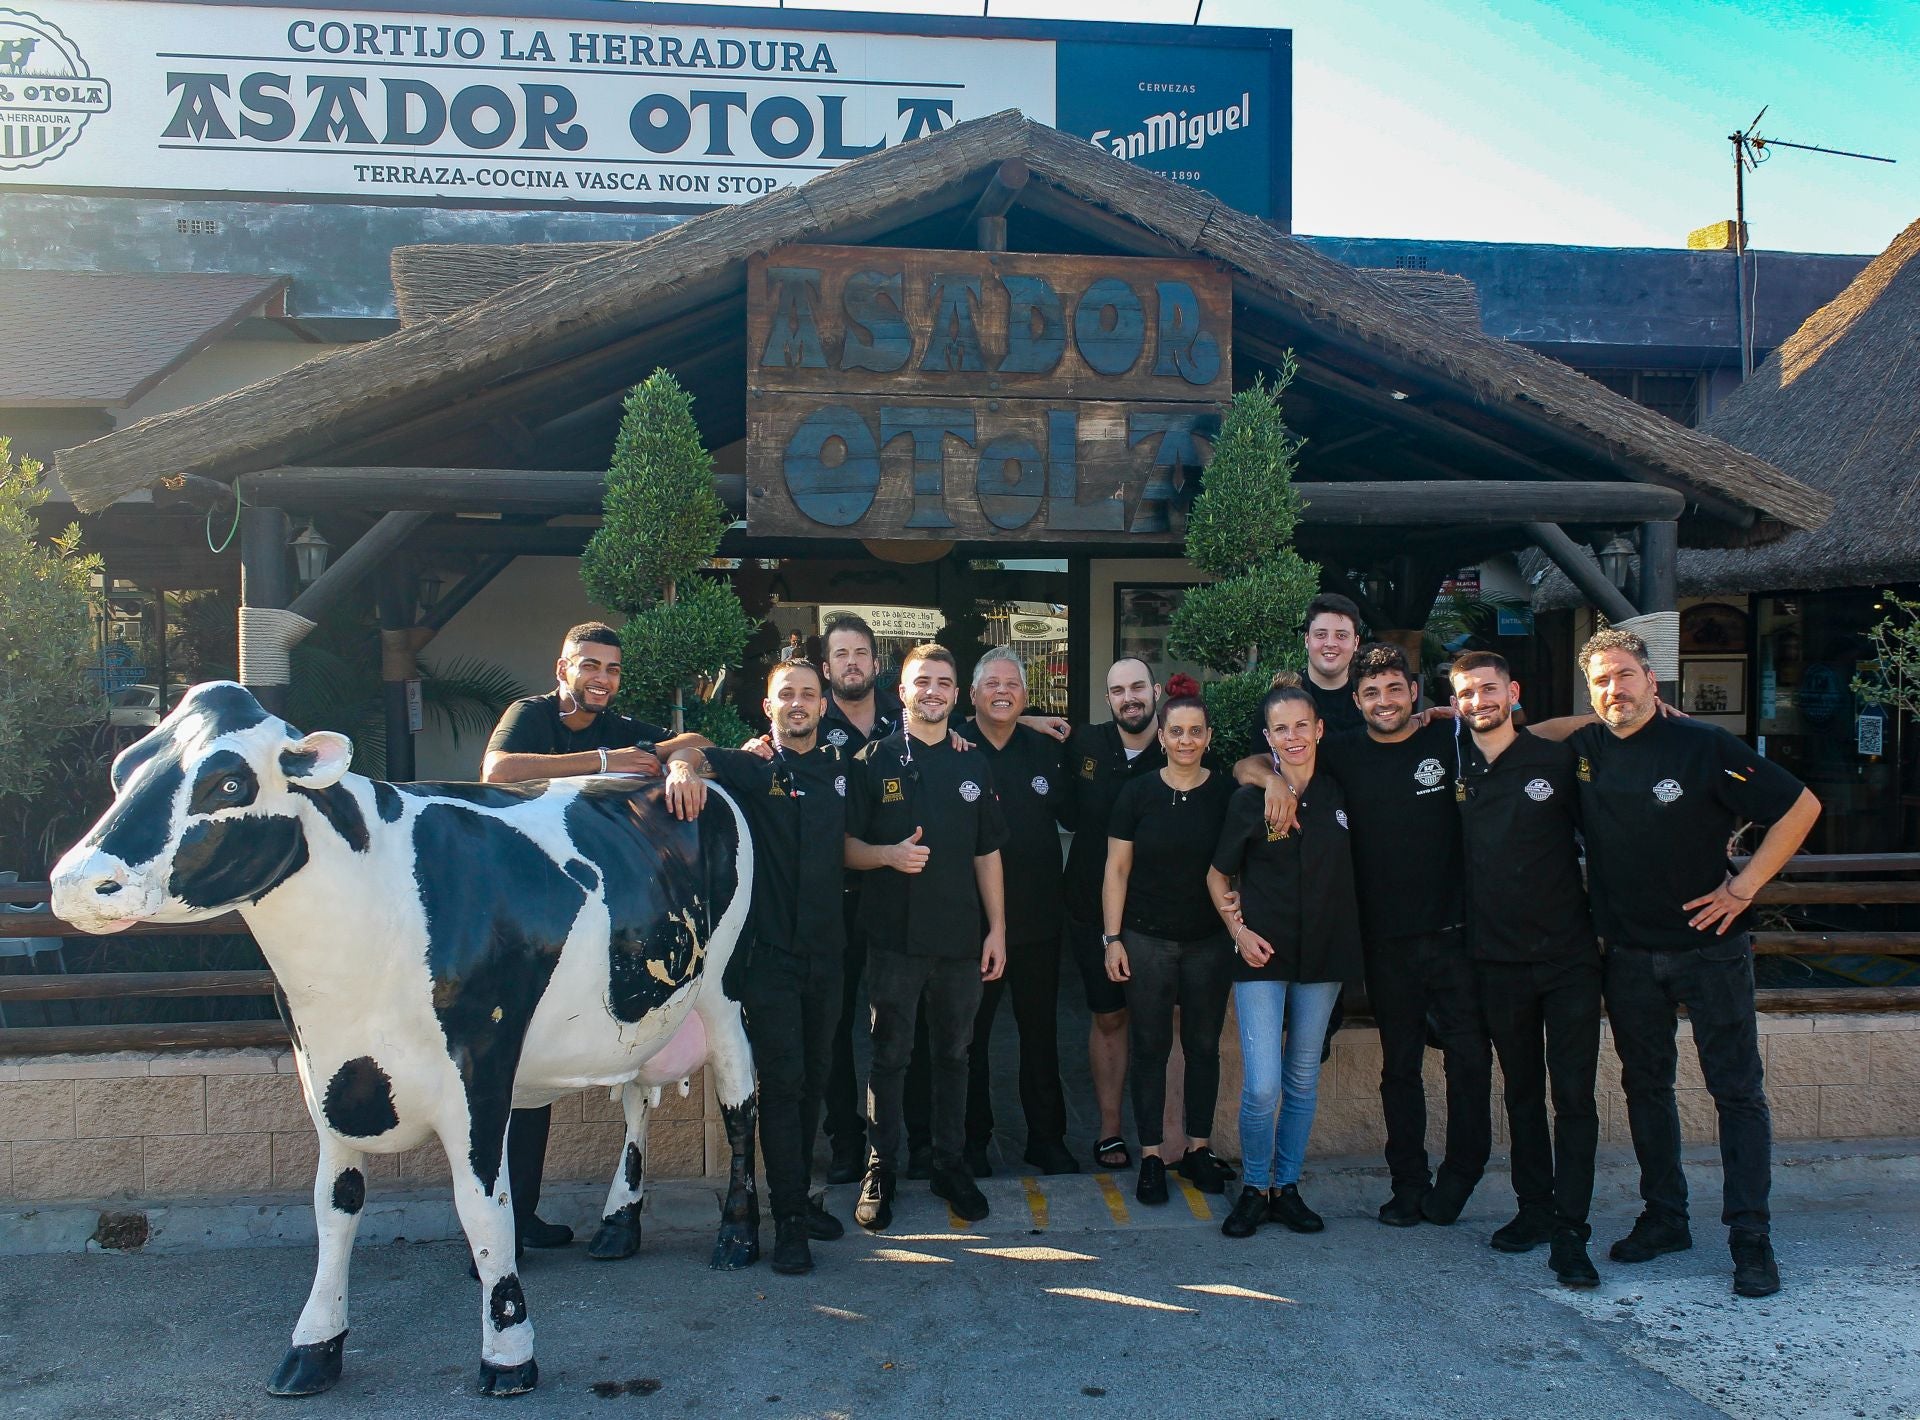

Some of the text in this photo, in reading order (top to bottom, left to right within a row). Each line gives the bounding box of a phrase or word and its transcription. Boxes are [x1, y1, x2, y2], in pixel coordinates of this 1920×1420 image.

[288, 21, 837, 79] CORTIJO LA HERRADURA
[23, 86, 103, 103] OTOLA
[1138, 82, 1196, 93] CERVEZAS
[8, 114, 71, 124] HERRADURA
[160, 72, 588, 151] ASADOR
[354, 165, 778, 195] TERRAZA-COCINA VASCA NON STOP
[1171, 171, 1200, 181] 1890
[761, 267, 1221, 385] ASADOR
[784, 405, 1221, 534] OTOLA
